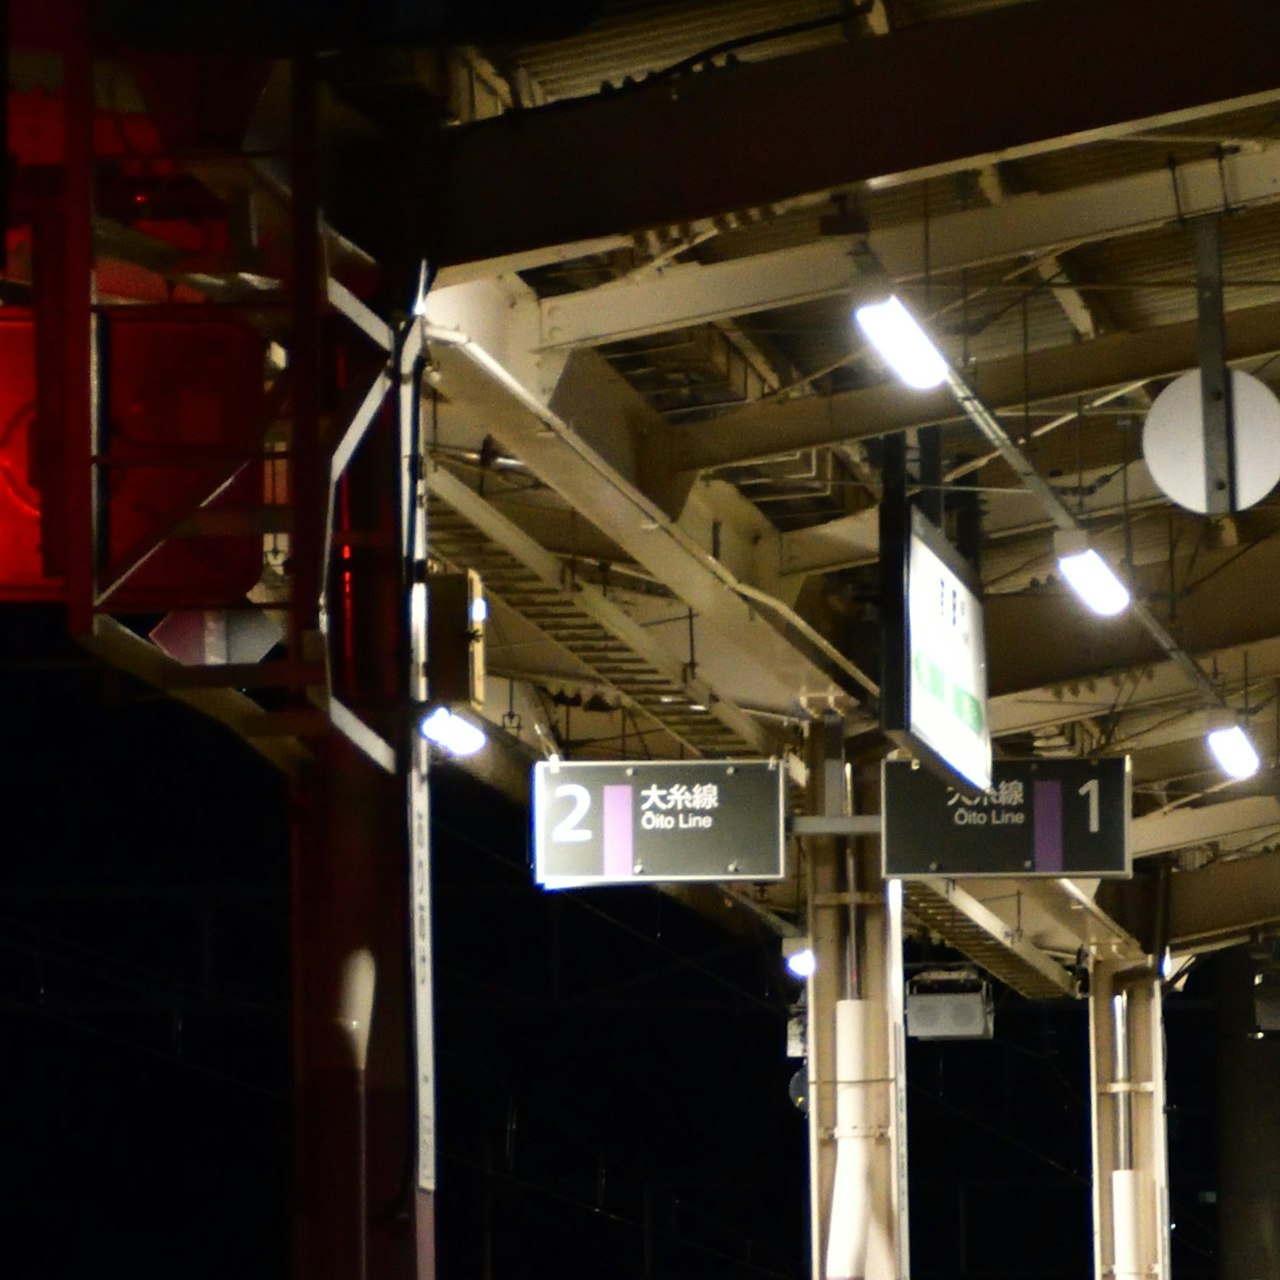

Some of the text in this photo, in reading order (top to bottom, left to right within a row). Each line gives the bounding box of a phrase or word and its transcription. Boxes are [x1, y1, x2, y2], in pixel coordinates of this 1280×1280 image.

[641, 783, 718, 809] 大糸線
[1078, 779, 1099, 833] 1
[552, 784, 592, 842] 2
[679, 813, 712, 829] Line
[991, 809, 1024, 825] Line
